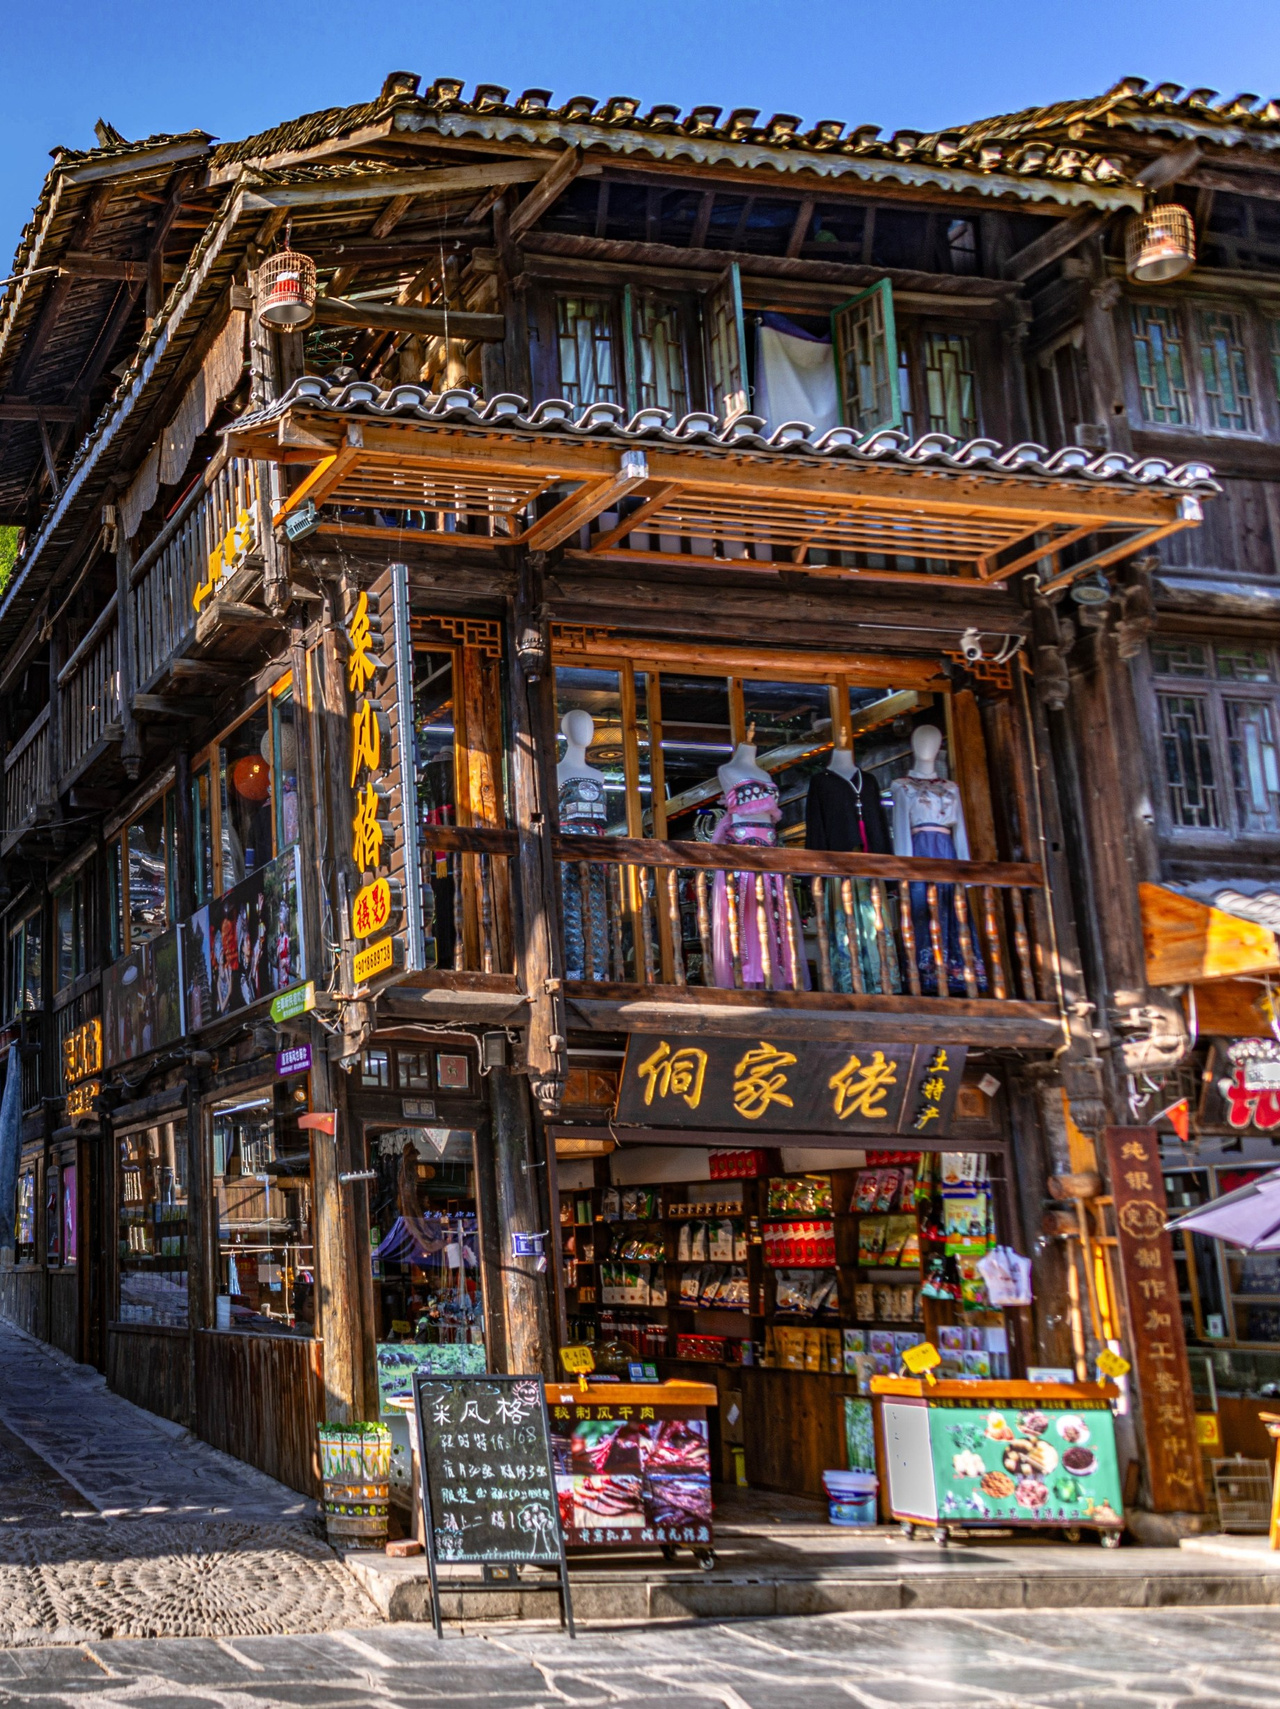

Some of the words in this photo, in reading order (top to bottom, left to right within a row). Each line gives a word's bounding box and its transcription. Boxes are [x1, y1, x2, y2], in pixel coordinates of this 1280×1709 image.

[349, 590, 383, 874] 采风格
[637, 1040, 897, 1120] 侗家佬
[914, 1048, 950, 1129] 土特产
[1121, 1141, 1153, 1191] 纯银
[432, 1395, 531, 1427] 采风格
[553, 1406, 656, 1420] 秘制风干肉
